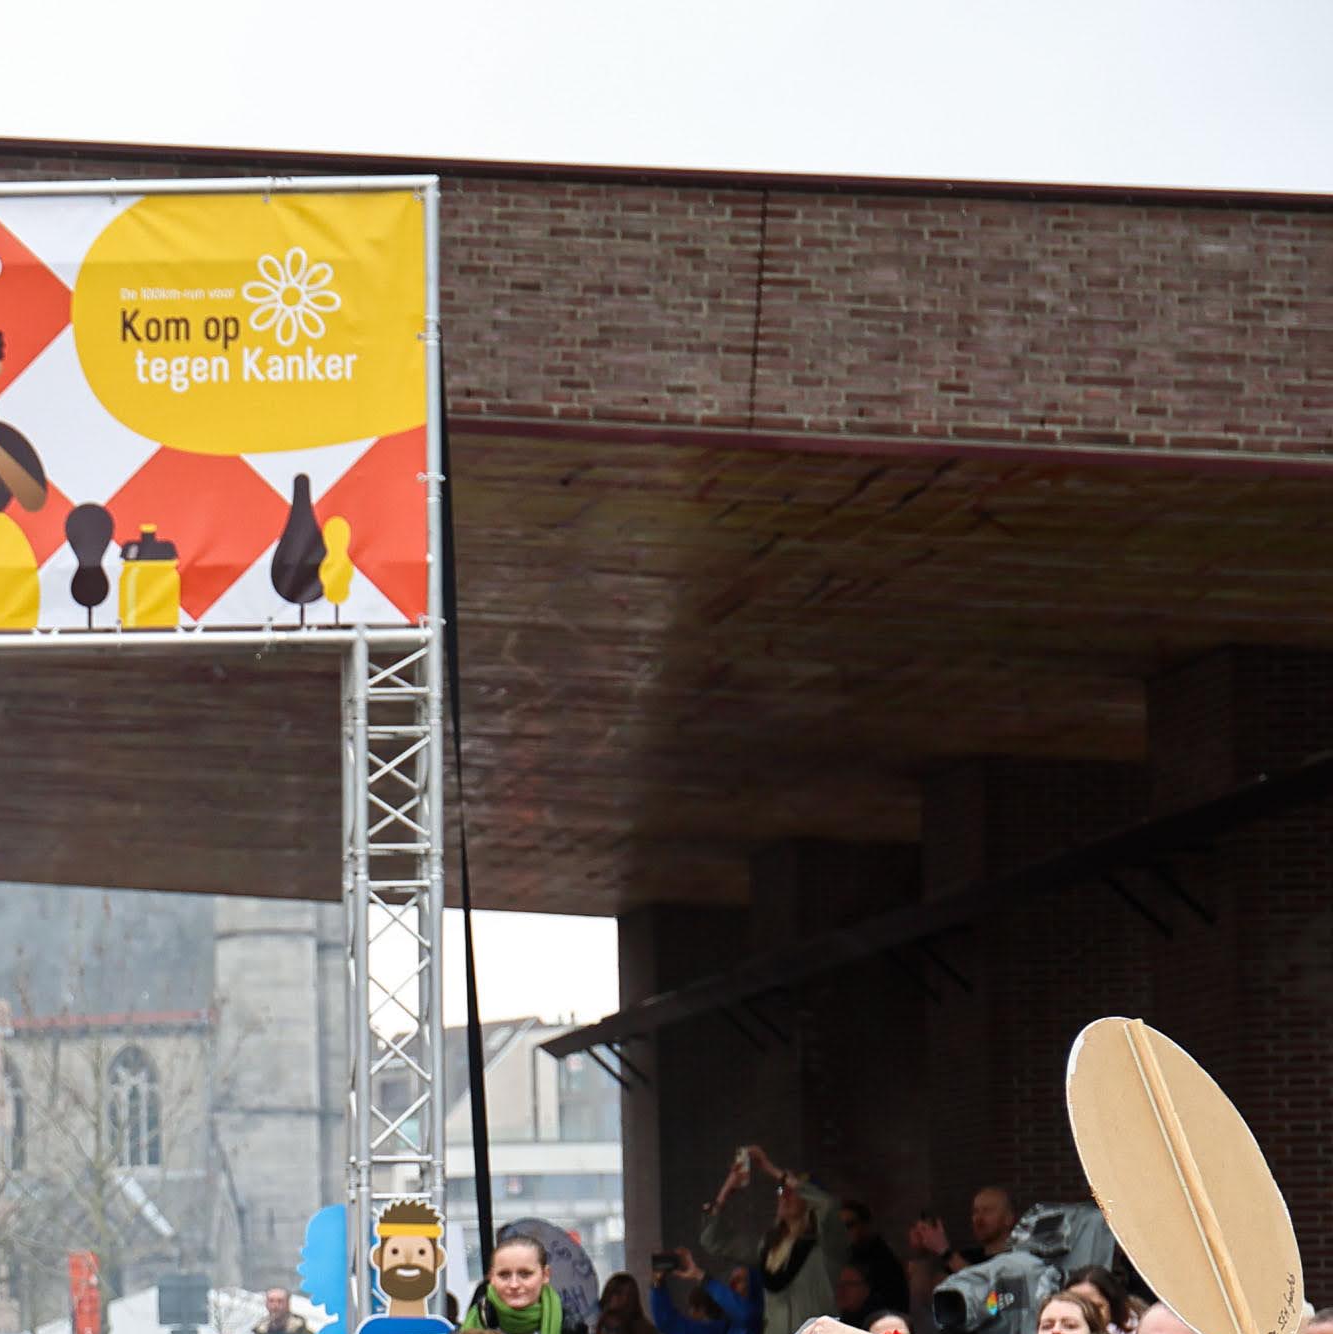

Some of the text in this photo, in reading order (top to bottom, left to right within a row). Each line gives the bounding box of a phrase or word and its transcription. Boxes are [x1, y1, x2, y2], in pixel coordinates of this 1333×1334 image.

[121, 309, 240, 350] Kom op
[135, 346, 358, 393] tegen Kanker
